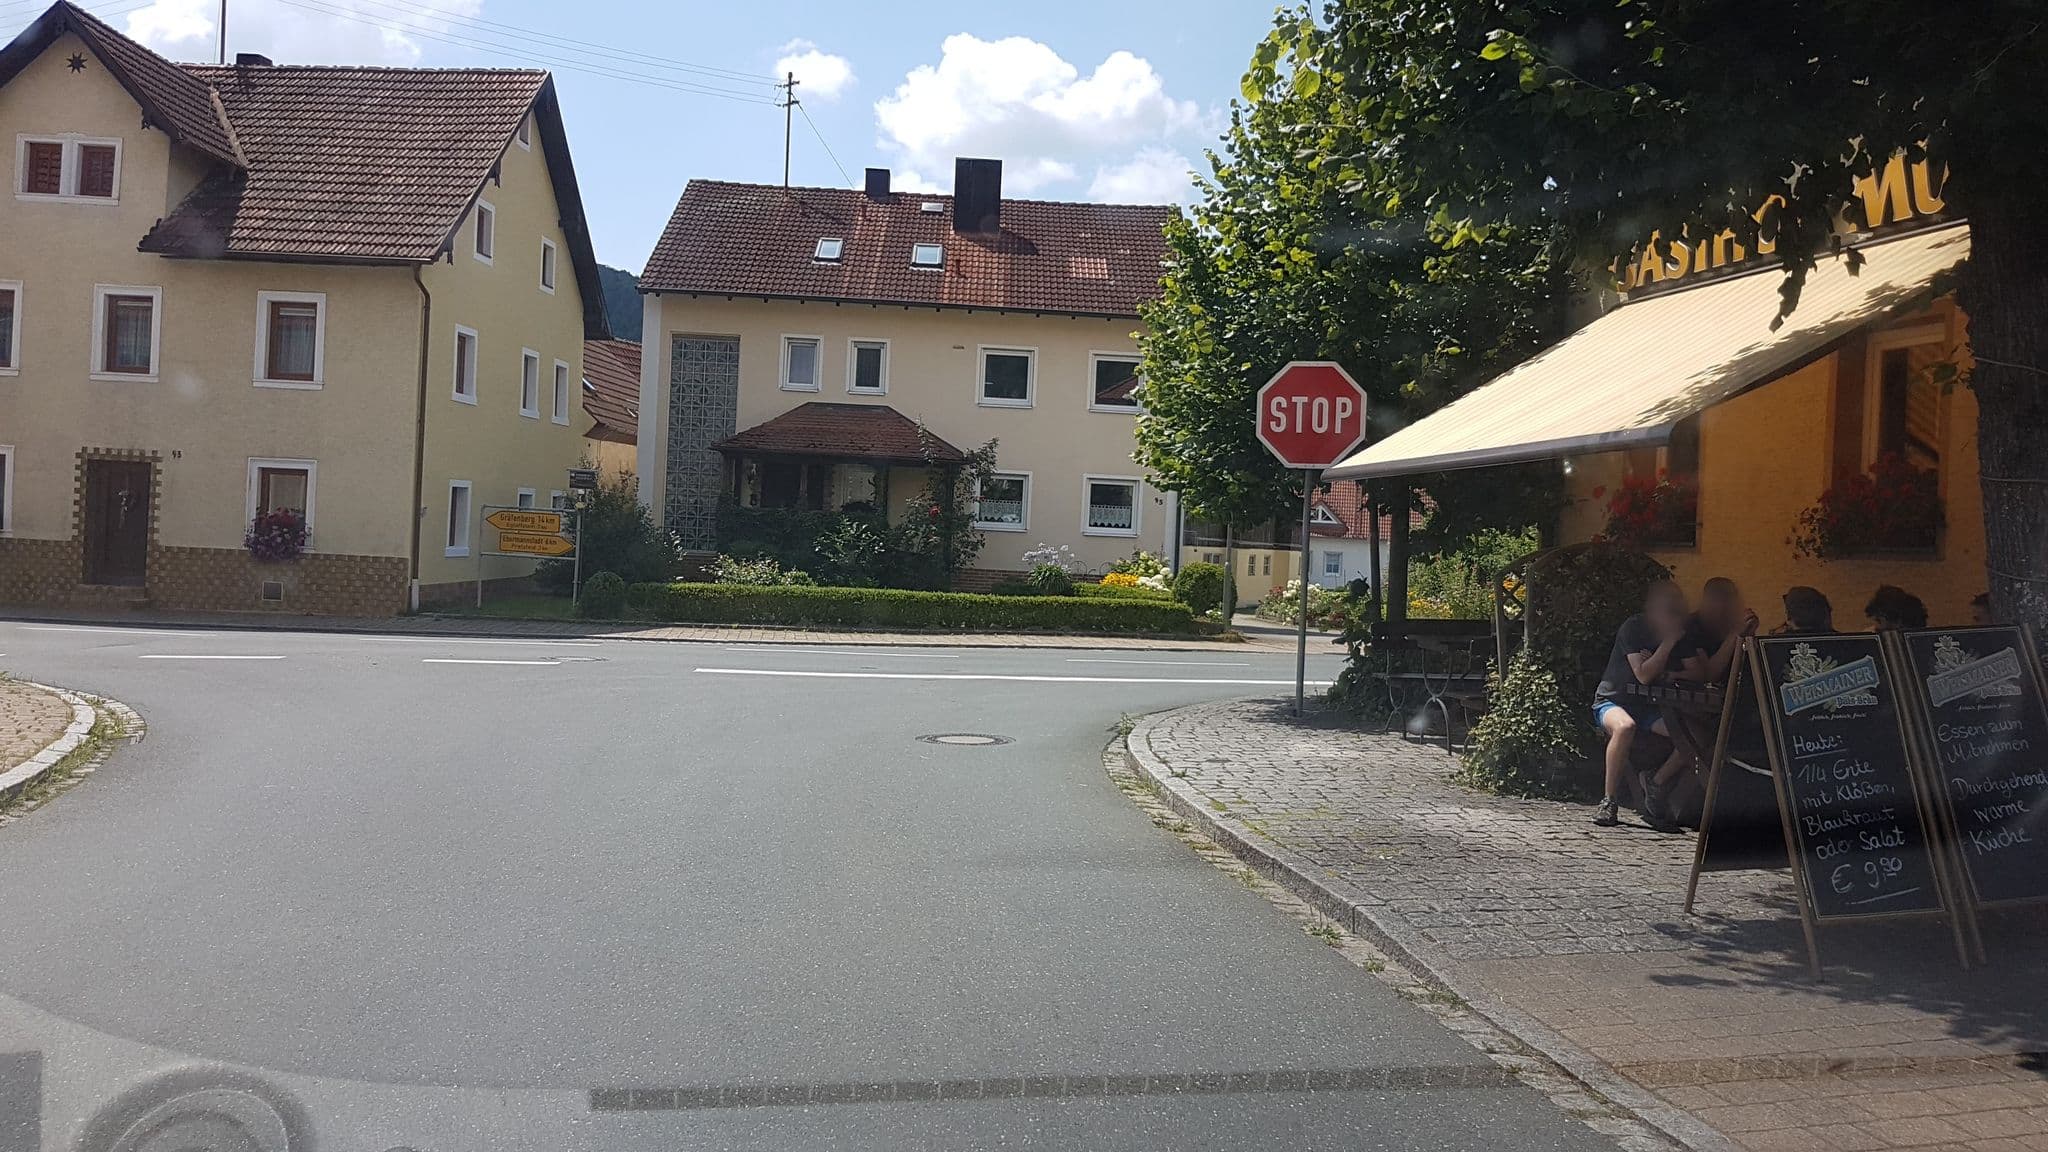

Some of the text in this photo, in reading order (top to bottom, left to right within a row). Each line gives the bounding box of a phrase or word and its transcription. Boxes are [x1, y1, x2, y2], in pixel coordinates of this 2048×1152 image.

[1270, 396, 1353, 433] STOP
[500, 513, 555, 525] Gräfenberg 14 km
[503, 535, 544, 545] Ebermannstadt
[1787, 666, 1874, 706] WEISMAINER
[1937, 719, 2024, 743] Essen zum
[1792, 734, 1843, 755] Heute:
[1798, 759, 1876, 784] 1/4 Ente
[1801, 790, 1833, 809] mit
[1859, 825, 1906, 851] Salat
[1968, 826, 2034, 856] Küche
